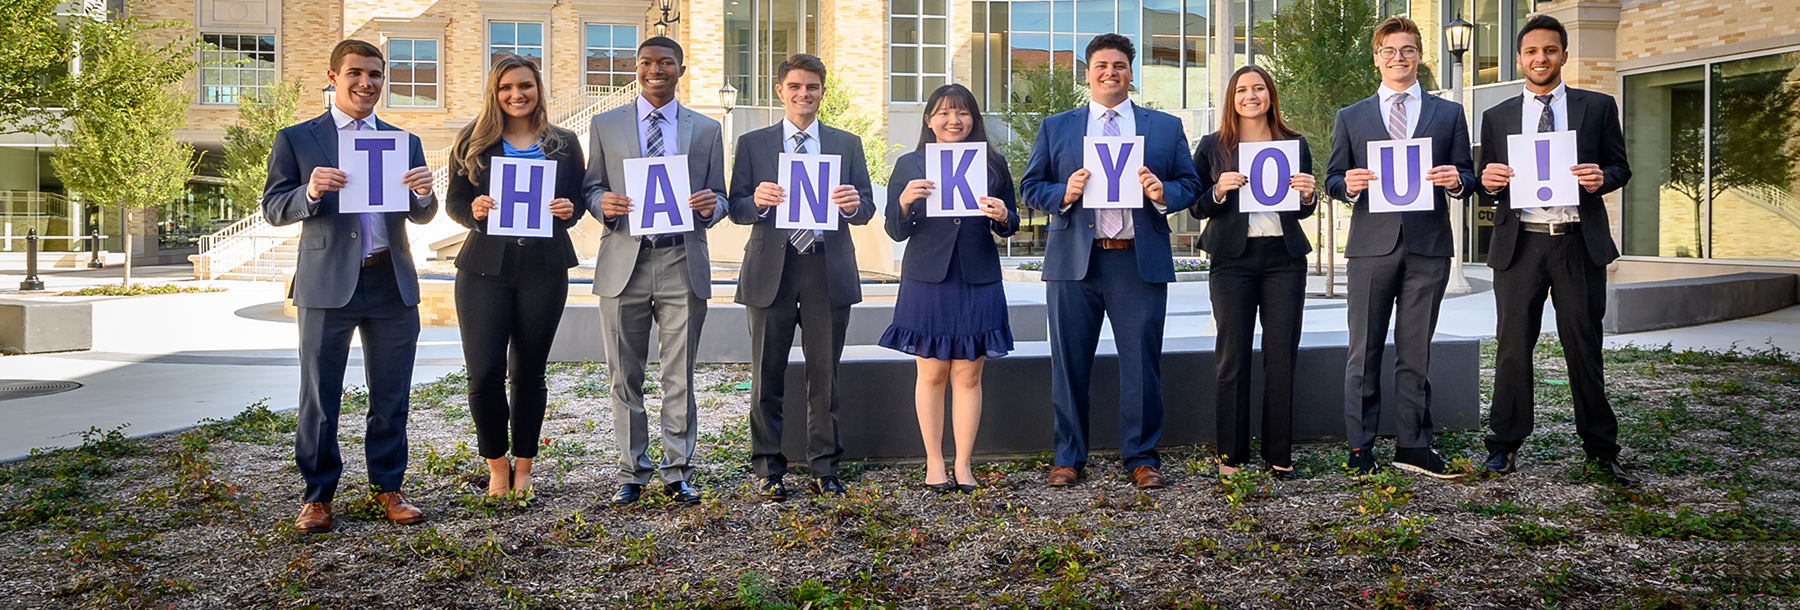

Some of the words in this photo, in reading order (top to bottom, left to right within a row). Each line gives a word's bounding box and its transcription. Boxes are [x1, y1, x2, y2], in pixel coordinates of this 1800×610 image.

[354, 138, 396, 206] T
[499, 163, 545, 230] H
[640, 163, 684, 229] A
[788, 160, 831, 224] N
[940, 149, 980, 211] K
[1094, 142, 1135, 203] Y
[1249, 147, 1292, 207] O
[1380, 144, 1421, 206] U
[1534, 139, 1553, 202] !
